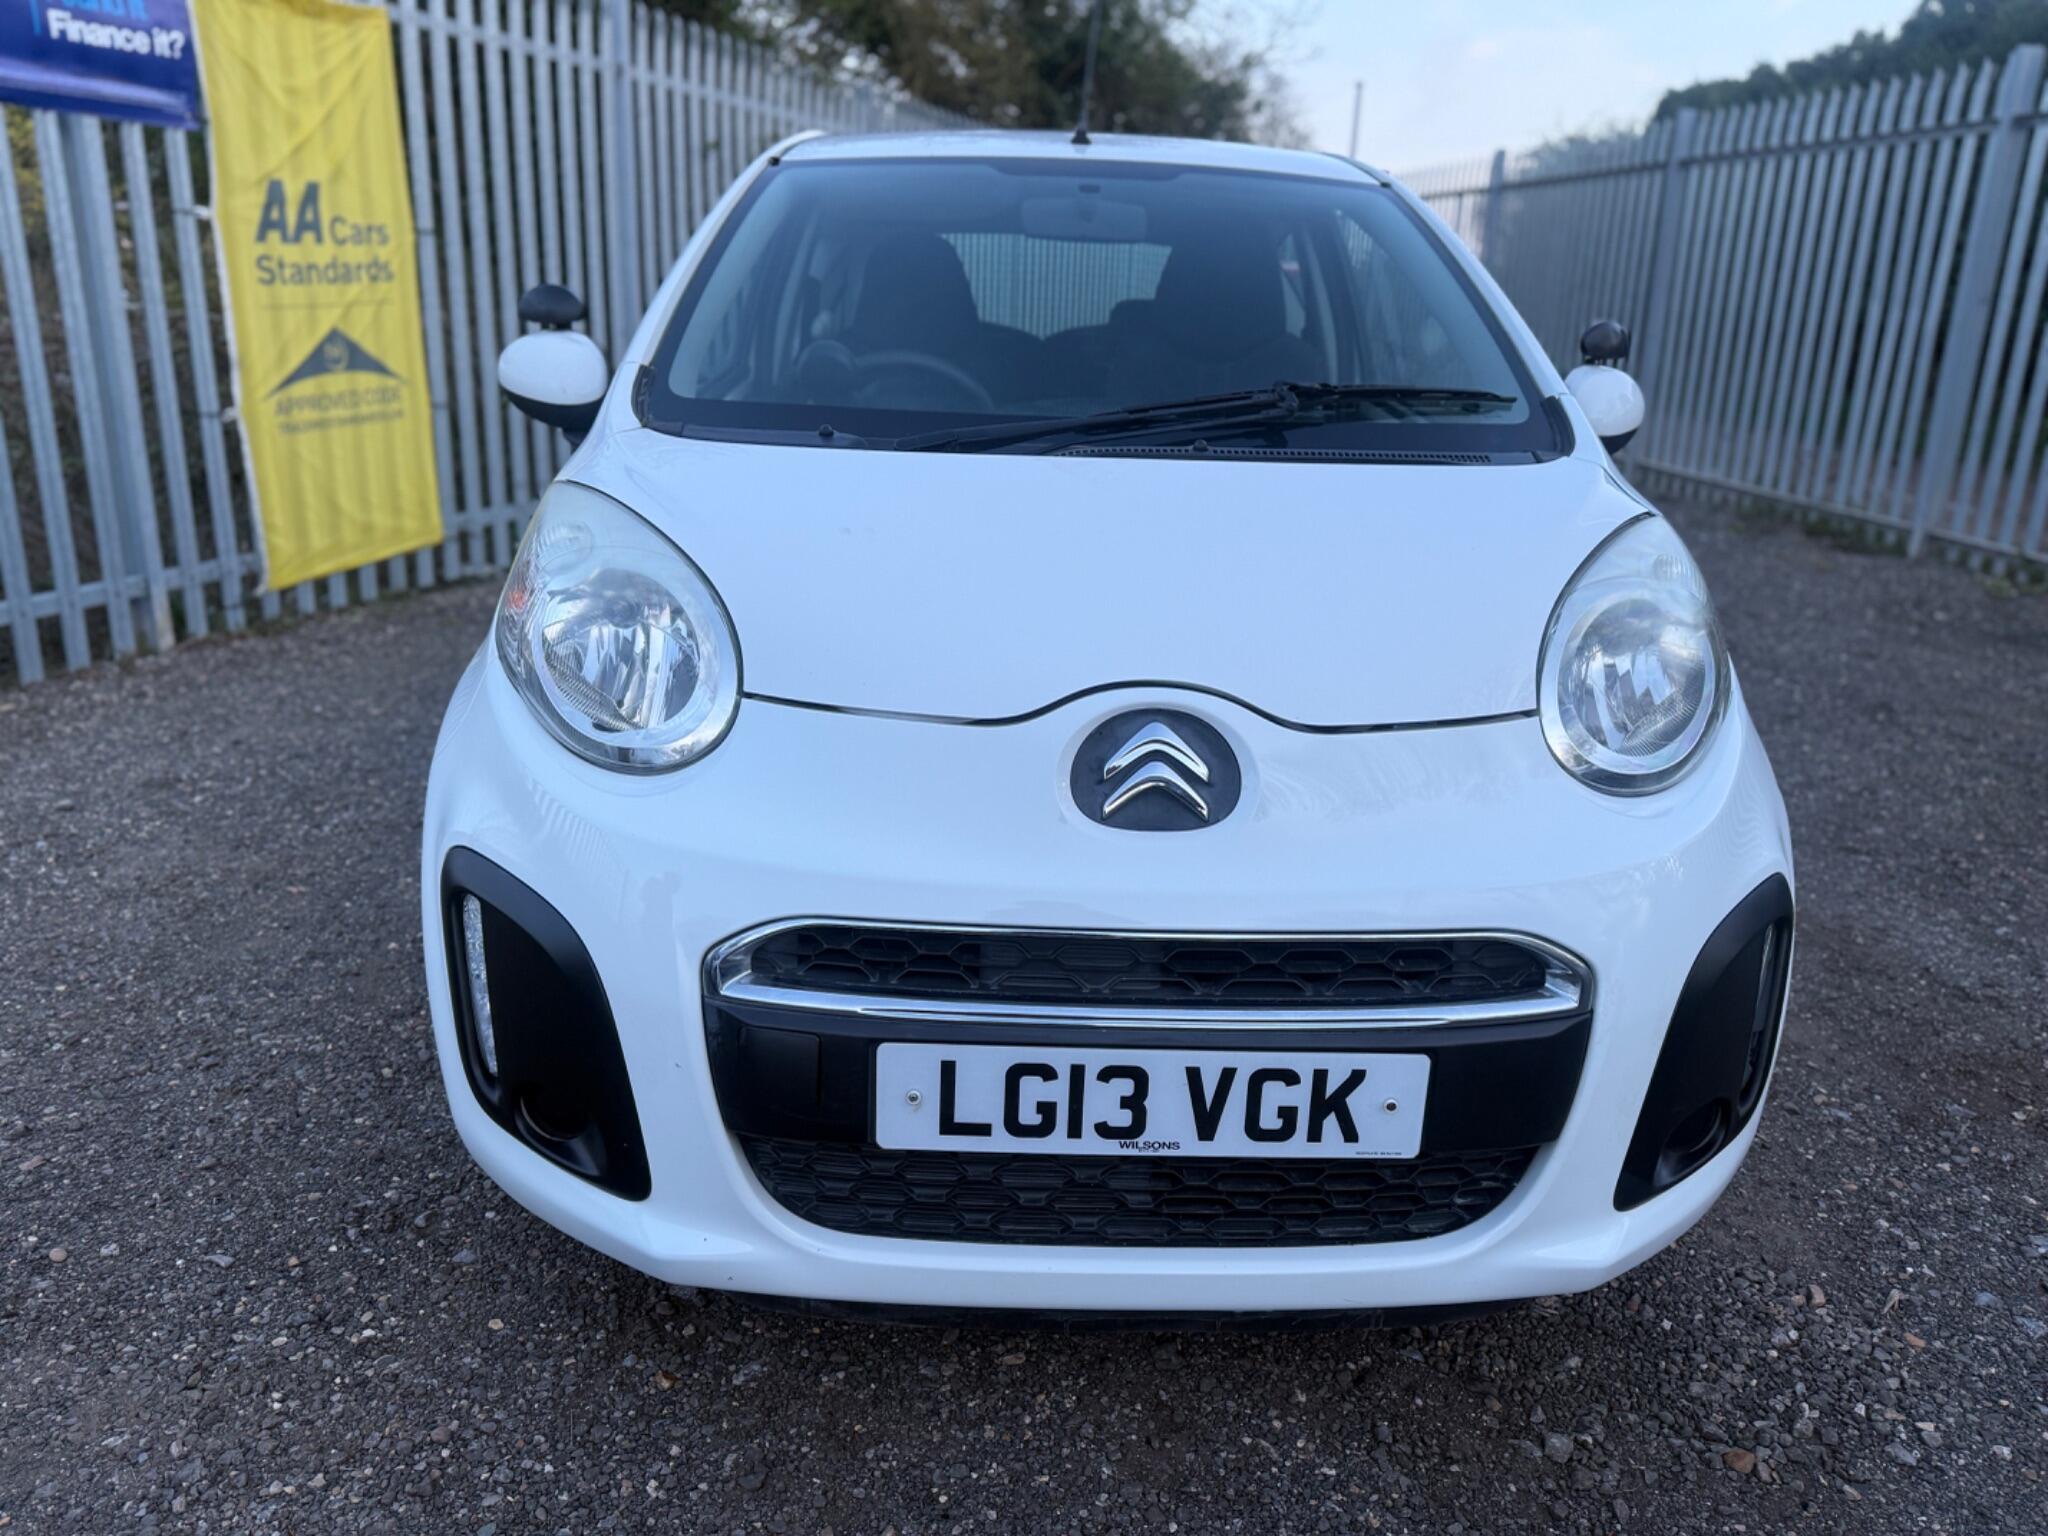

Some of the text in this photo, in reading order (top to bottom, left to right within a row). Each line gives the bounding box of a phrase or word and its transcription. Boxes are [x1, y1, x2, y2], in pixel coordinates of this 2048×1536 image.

[47, 8, 150, 55] Finance
[151, 27, 185, 59] it?
[256, 179, 390, 246] AA Cars
[255, 254, 395, 285] Standards
[938, 1059, 1367, 1143] LG13 VGK
[1118, 1140, 1181, 1151] WILSONS
